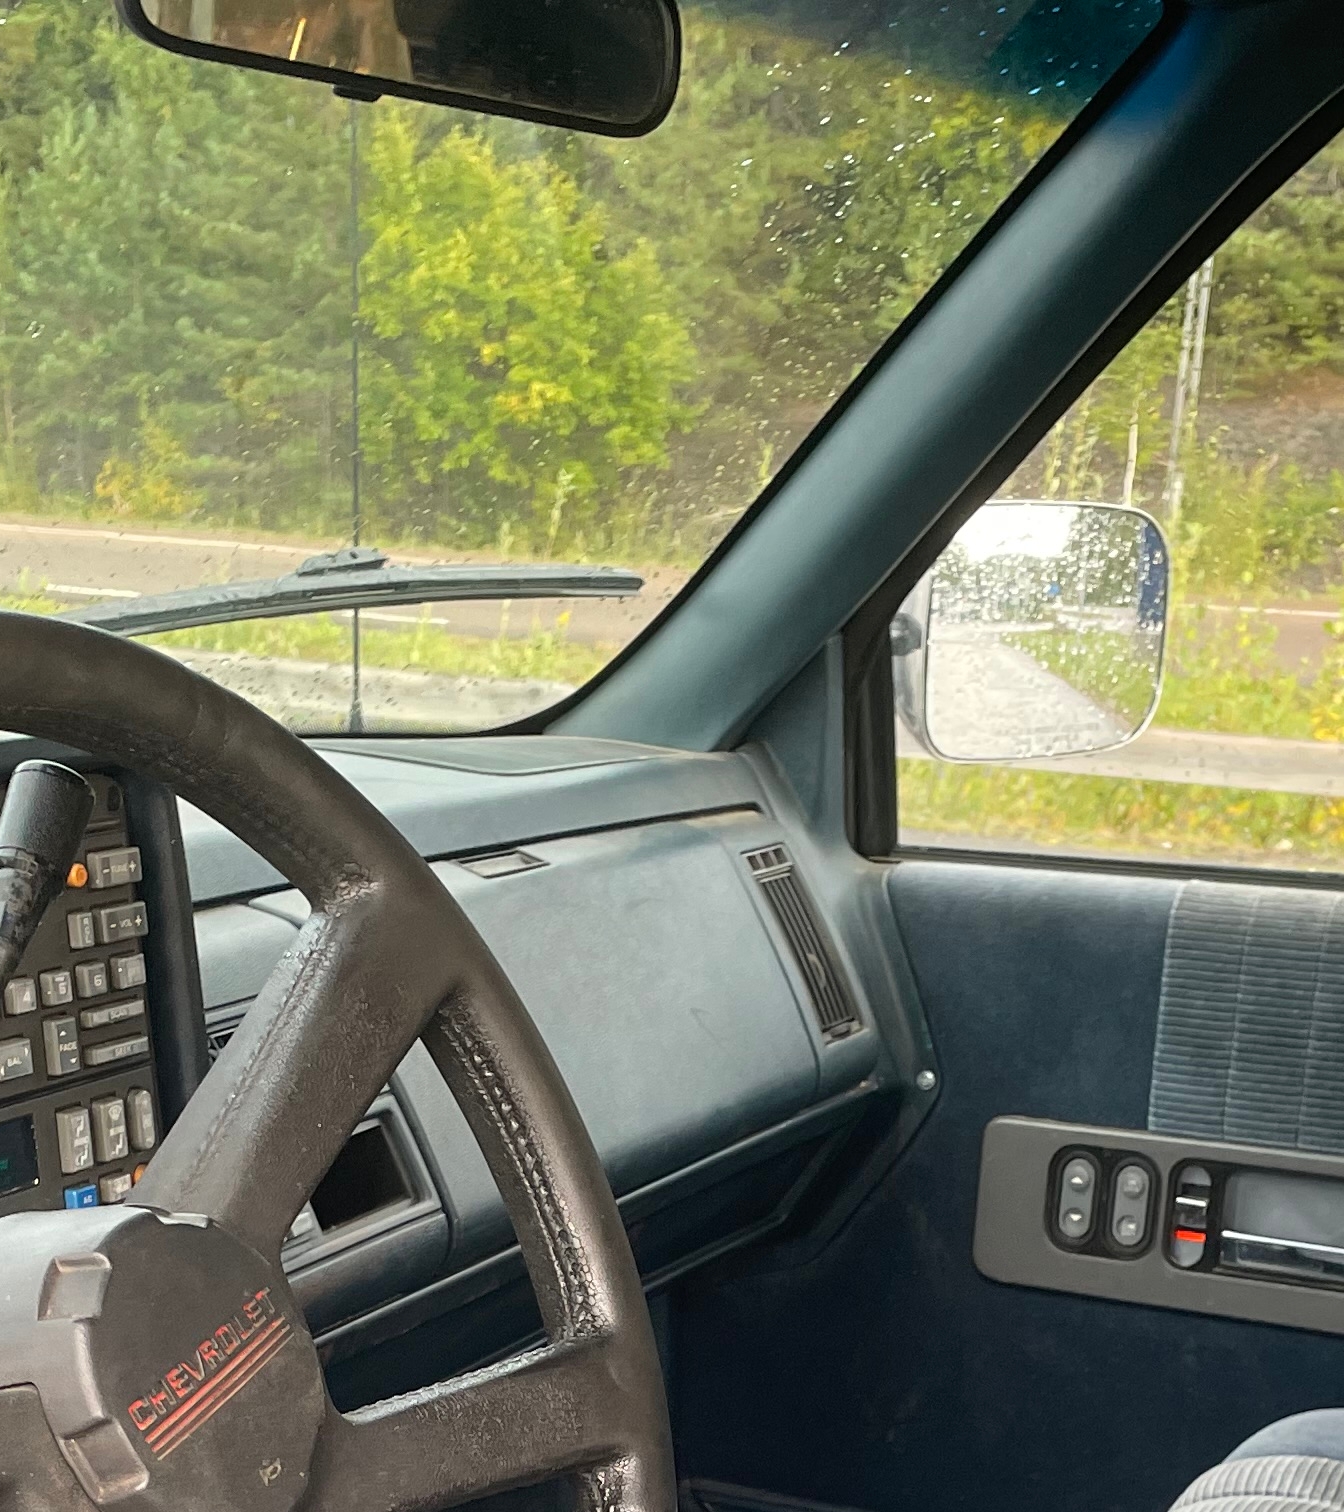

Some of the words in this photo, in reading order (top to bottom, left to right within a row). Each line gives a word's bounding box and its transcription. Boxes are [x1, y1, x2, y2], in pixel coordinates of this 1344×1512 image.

[119, 918, 133, 928] VOL
[93, 974, 103, 987] 6
[7, 1056, 23, 1068] BAL
[128, 1286, 275, 1431] CHEVROLET
